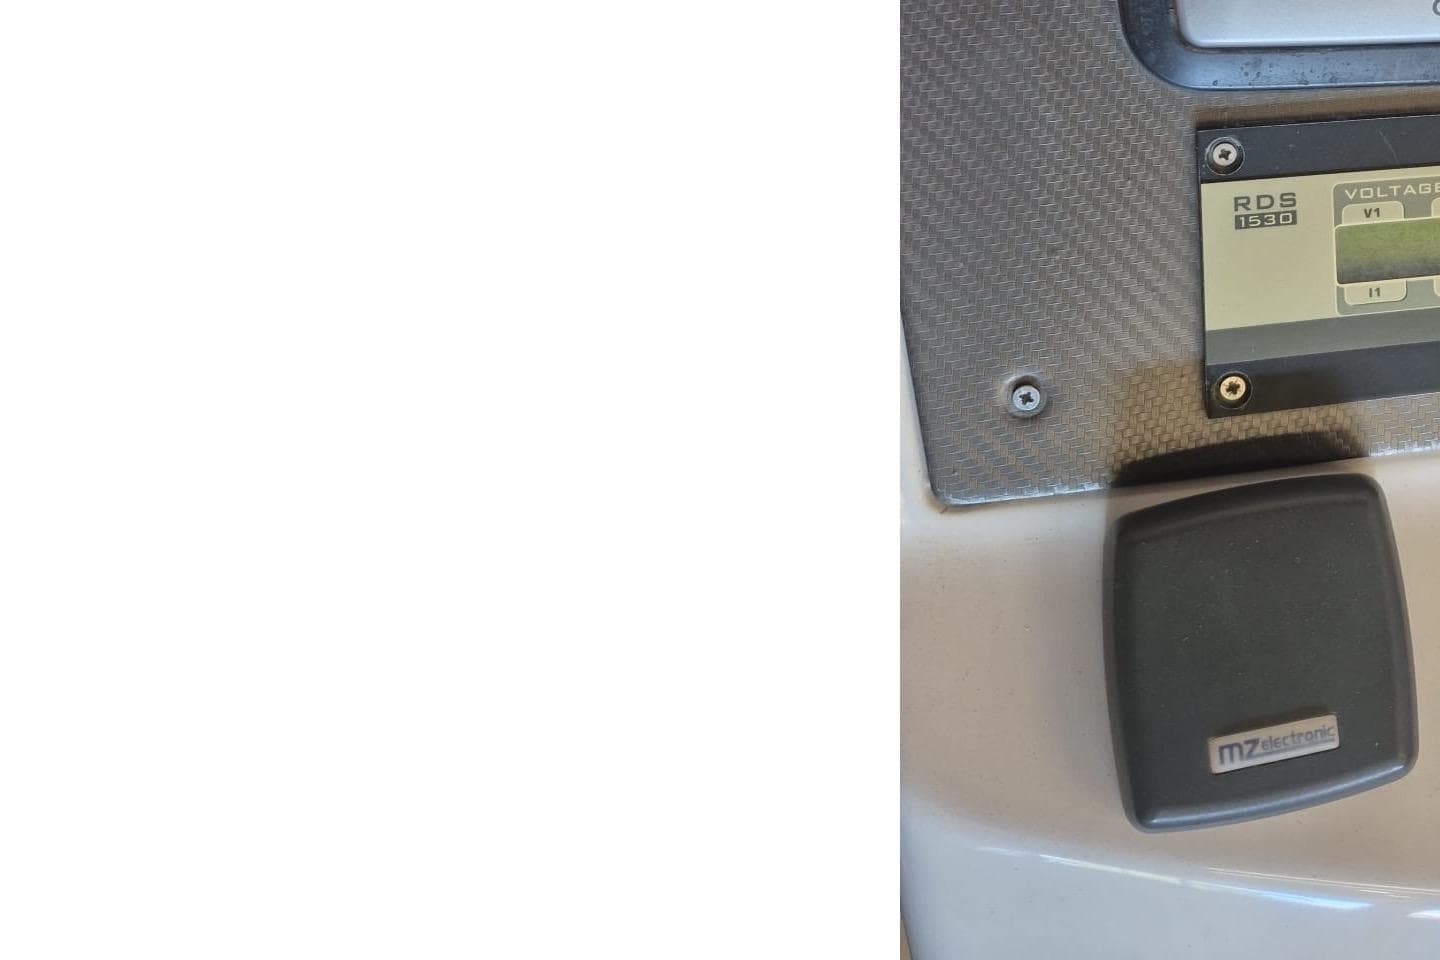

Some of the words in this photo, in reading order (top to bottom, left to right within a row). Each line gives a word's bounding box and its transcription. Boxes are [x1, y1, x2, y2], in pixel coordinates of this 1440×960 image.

[1234, 192, 1297, 212] RDS
[1239, 212, 1293, 227] 1530
[1364, 207, 1381, 218] V1
[1369, 287, 1381, 297] I1
[1261, 724, 1335, 751] electronic
